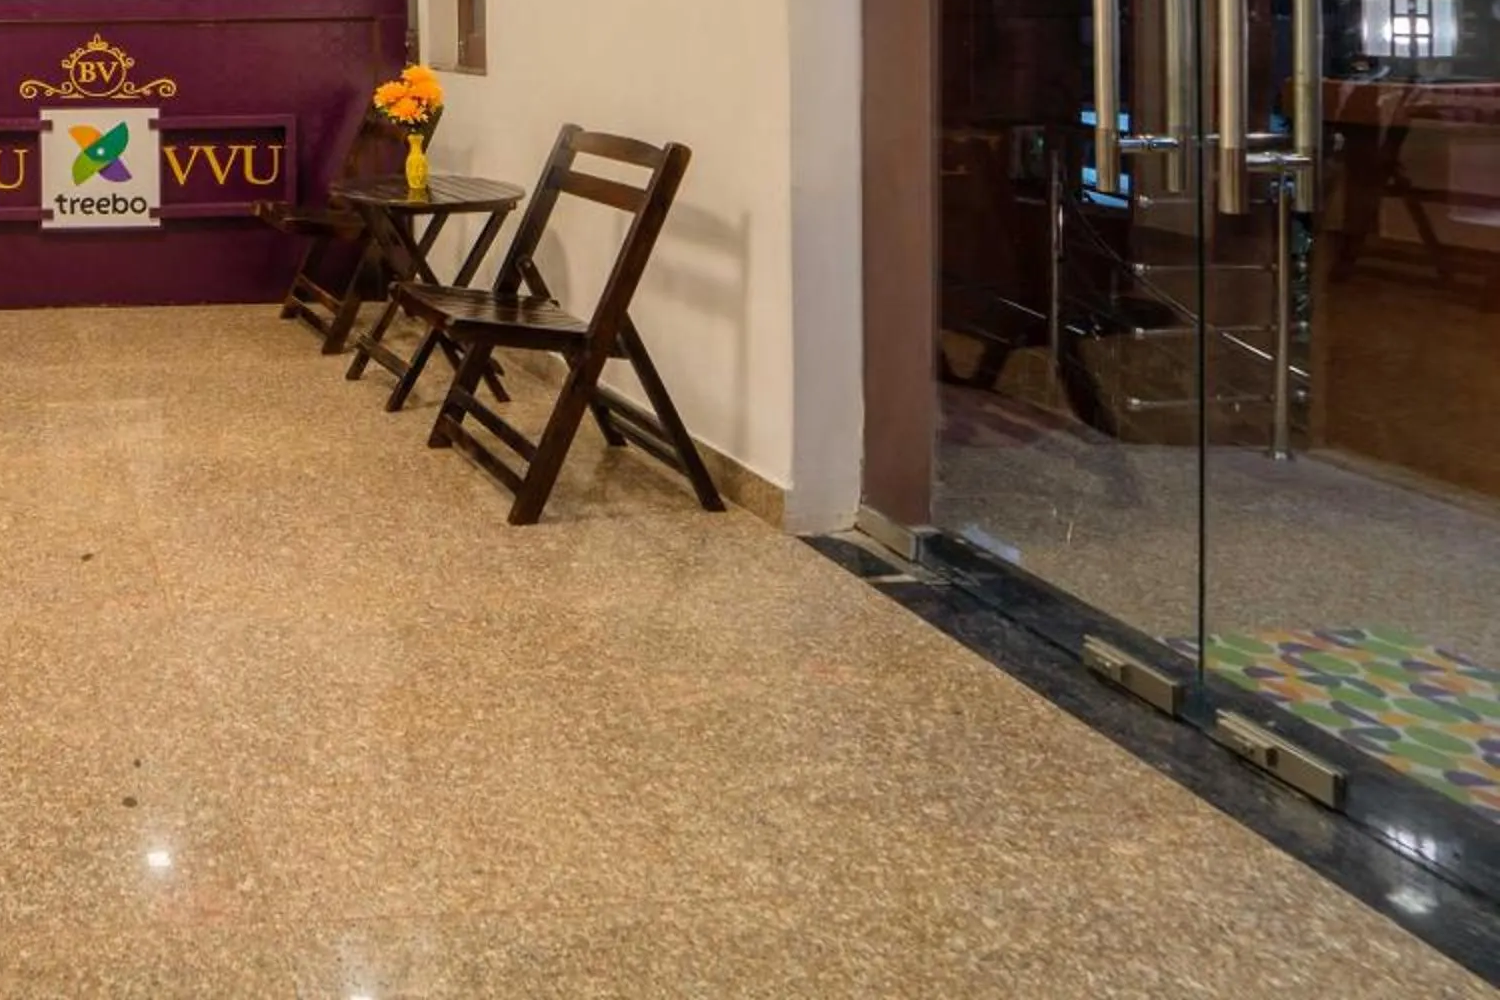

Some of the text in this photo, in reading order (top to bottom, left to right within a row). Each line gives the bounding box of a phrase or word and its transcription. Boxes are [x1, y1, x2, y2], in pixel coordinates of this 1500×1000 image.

[79, 61, 119, 83] BV
[163, 145, 285, 185] VVU
[54, 193, 147, 217] treebo
